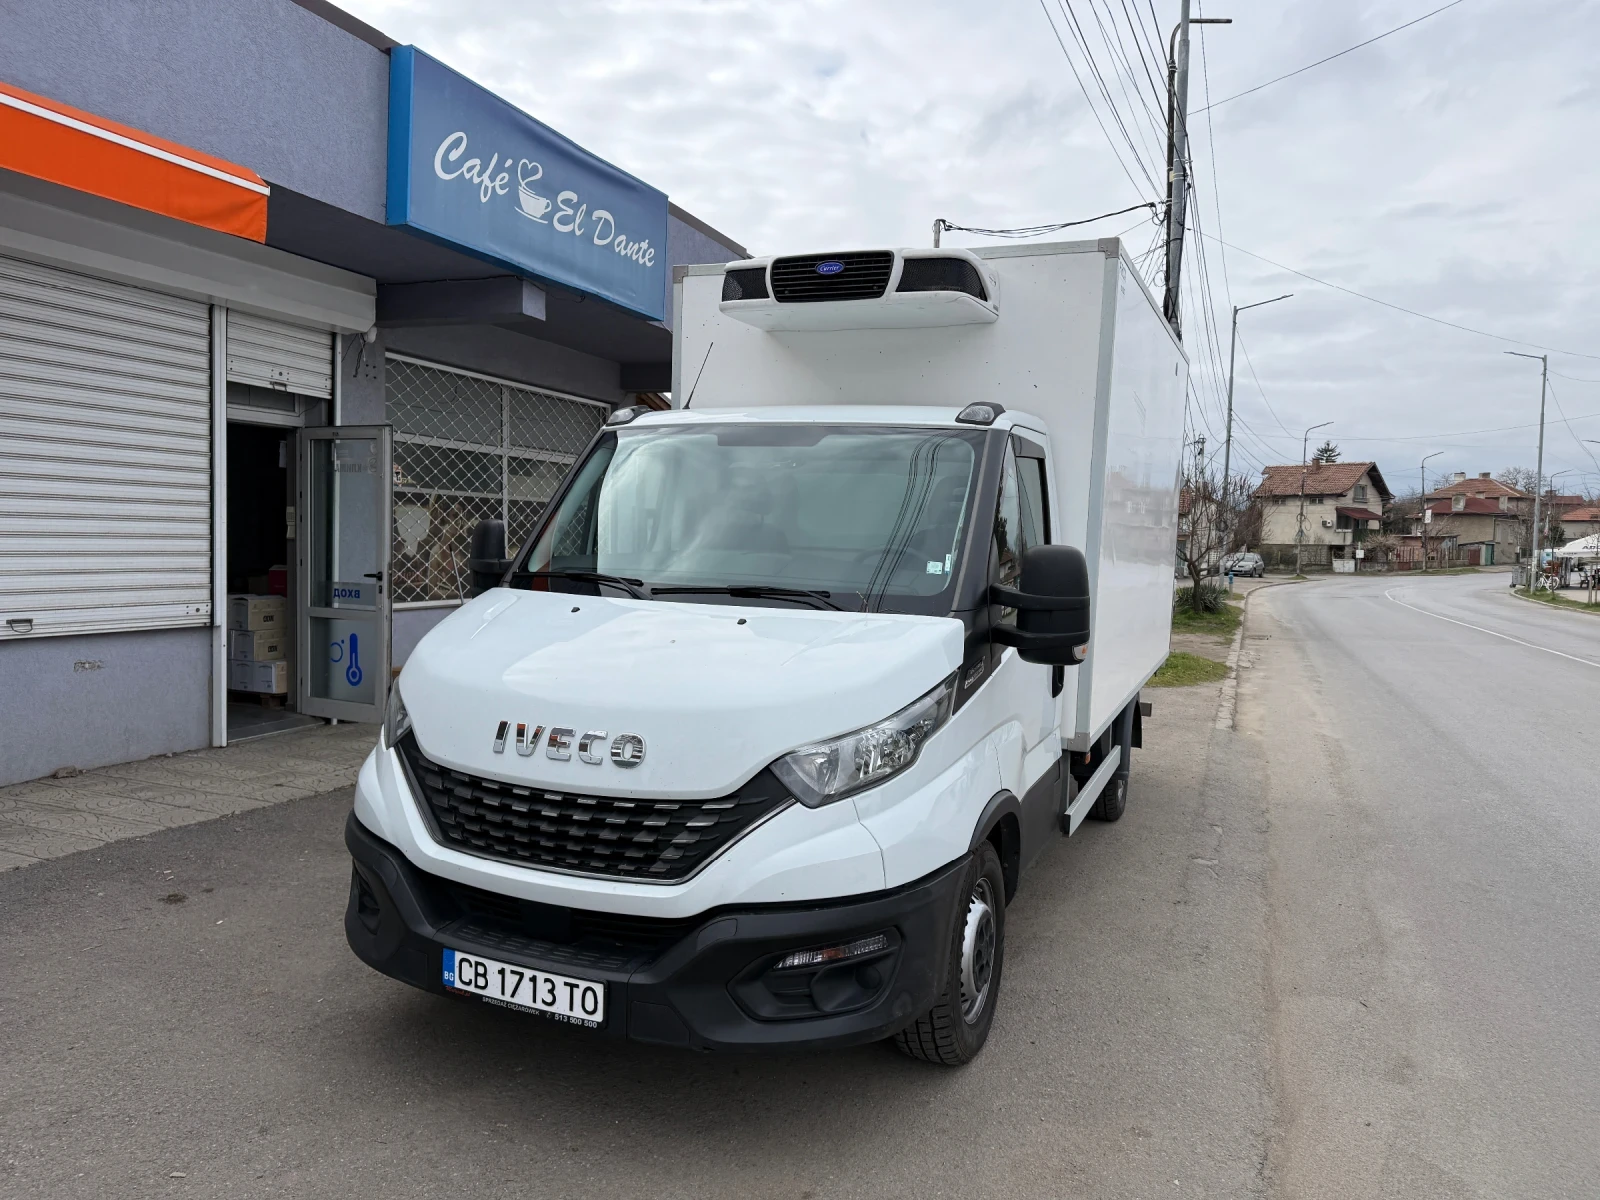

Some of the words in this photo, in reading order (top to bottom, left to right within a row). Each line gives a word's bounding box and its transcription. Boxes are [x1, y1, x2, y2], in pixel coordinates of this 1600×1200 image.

[434, 131, 513, 203] Café
[553, 190, 587, 236] El
[592, 210, 655, 267] Dante
[493, 720, 648, 769] IVECO
[444, 970, 454, 982] BG
[458, 957, 489, 991] CB
[497, 967, 557, 1007] 1713
[564, 981, 599, 1016] TO
[554, 1013, 568, 1022] 513
[570, 1017, 582, 1025] 500
[584, 1020, 598, 1028] 500
